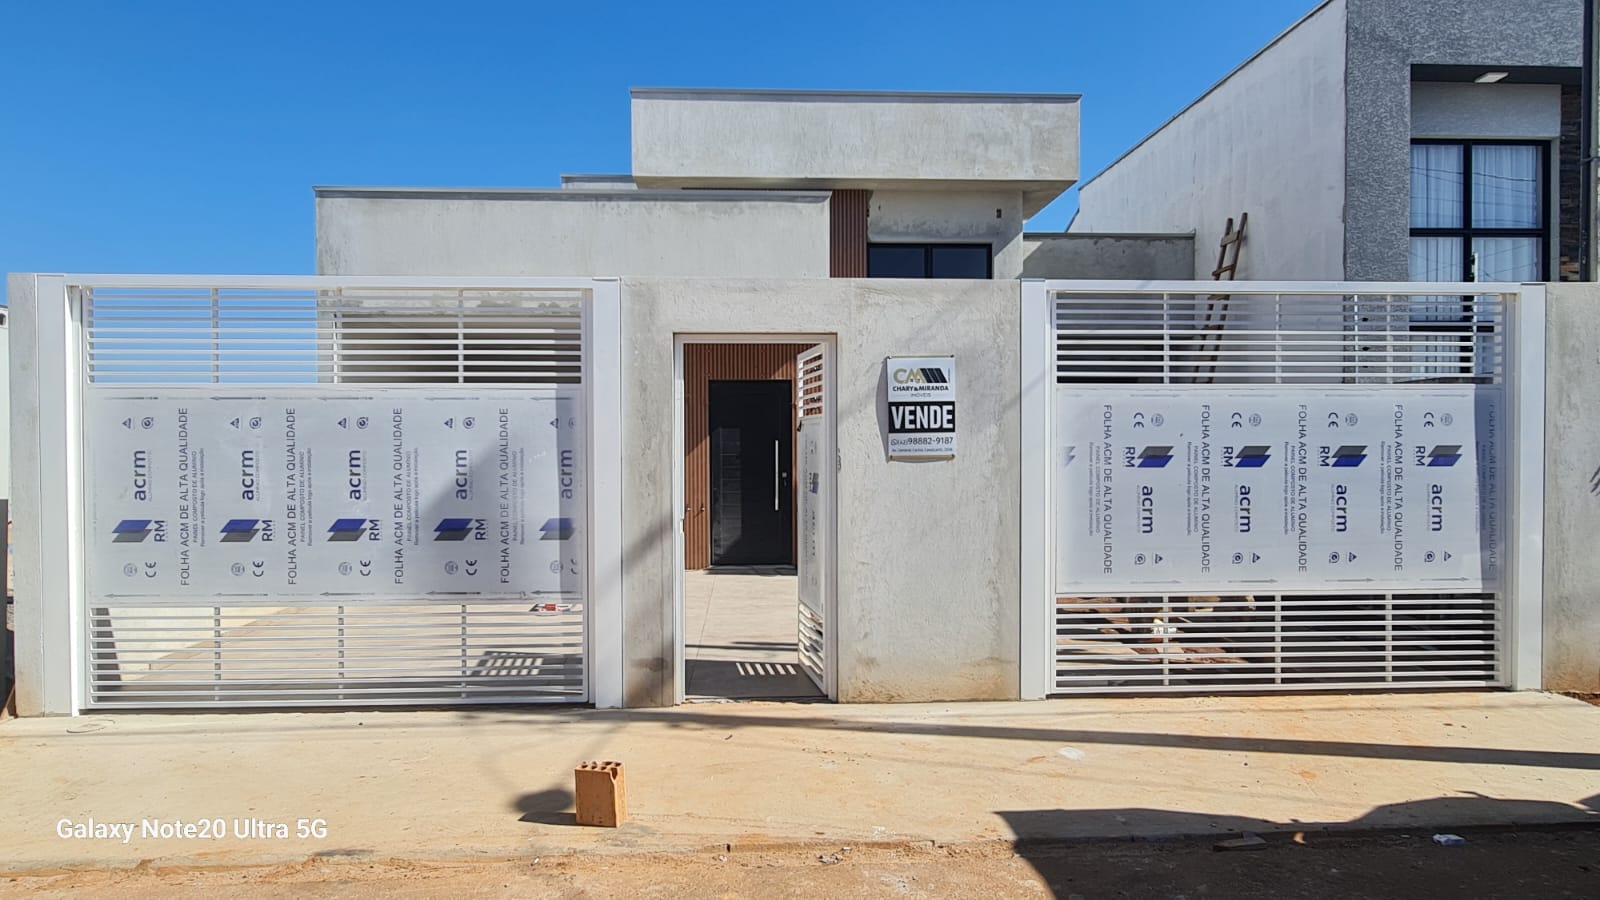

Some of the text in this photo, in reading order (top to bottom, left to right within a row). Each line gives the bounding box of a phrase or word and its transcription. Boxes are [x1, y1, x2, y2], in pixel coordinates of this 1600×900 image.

[891, 405, 953, 429] VENDE
[1298, 405, 1306, 438] FOLHA
[134, 450, 146, 500] acrm
[242, 450, 253, 500] acrm
[349, 450, 361, 499] acrm
[455, 450, 469, 501] acrm
[560, 450, 572, 498] acrm
[1125, 447, 1135, 467] RM
[1223, 446, 1233, 466] RM
[1298, 441, 1306, 464] ACM
[1298, 468, 1306, 481] DE
[1320, 446, 1329, 466] RM
[1394, 467, 1402, 480] DE
[1415, 446, 1425, 465] RM
[178, 408, 189, 585] FOLHA ACM DE ALTA QUALIDADE
[286, 408, 296, 584] FOLHA ACM DE ALTA QUALIDADE
[393, 408, 403, 583] FOLHA ACM DE ALTA QUALIDADE
[498, 409, 509, 583] FOLHA ACM DE ALTA QUALIDADE
[1103, 405, 1112, 573] FOLHA ACM DE ALTA QUALIDADE
[1142, 486, 1152, 533] acrm
[1201, 405, 1210, 572] FOLHA ACM DE ALTA QUALIDADE
[1240, 485, 1250, 532] acrm
[1336, 484, 1346, 531] acrm
[1394, 483, 1402, 509] ALTA
[1432, 484, 1442, 530] acrm
[154, 520, 165, 541] RM
[261, 520, 272, 541] RM
[369, 519, 379, 540] RM
[475, 519, 486, 540] RM
[1298, 512, 1306, 571] QUALIDADE
[1394, 512, 1402, 570] QUALIDADE
